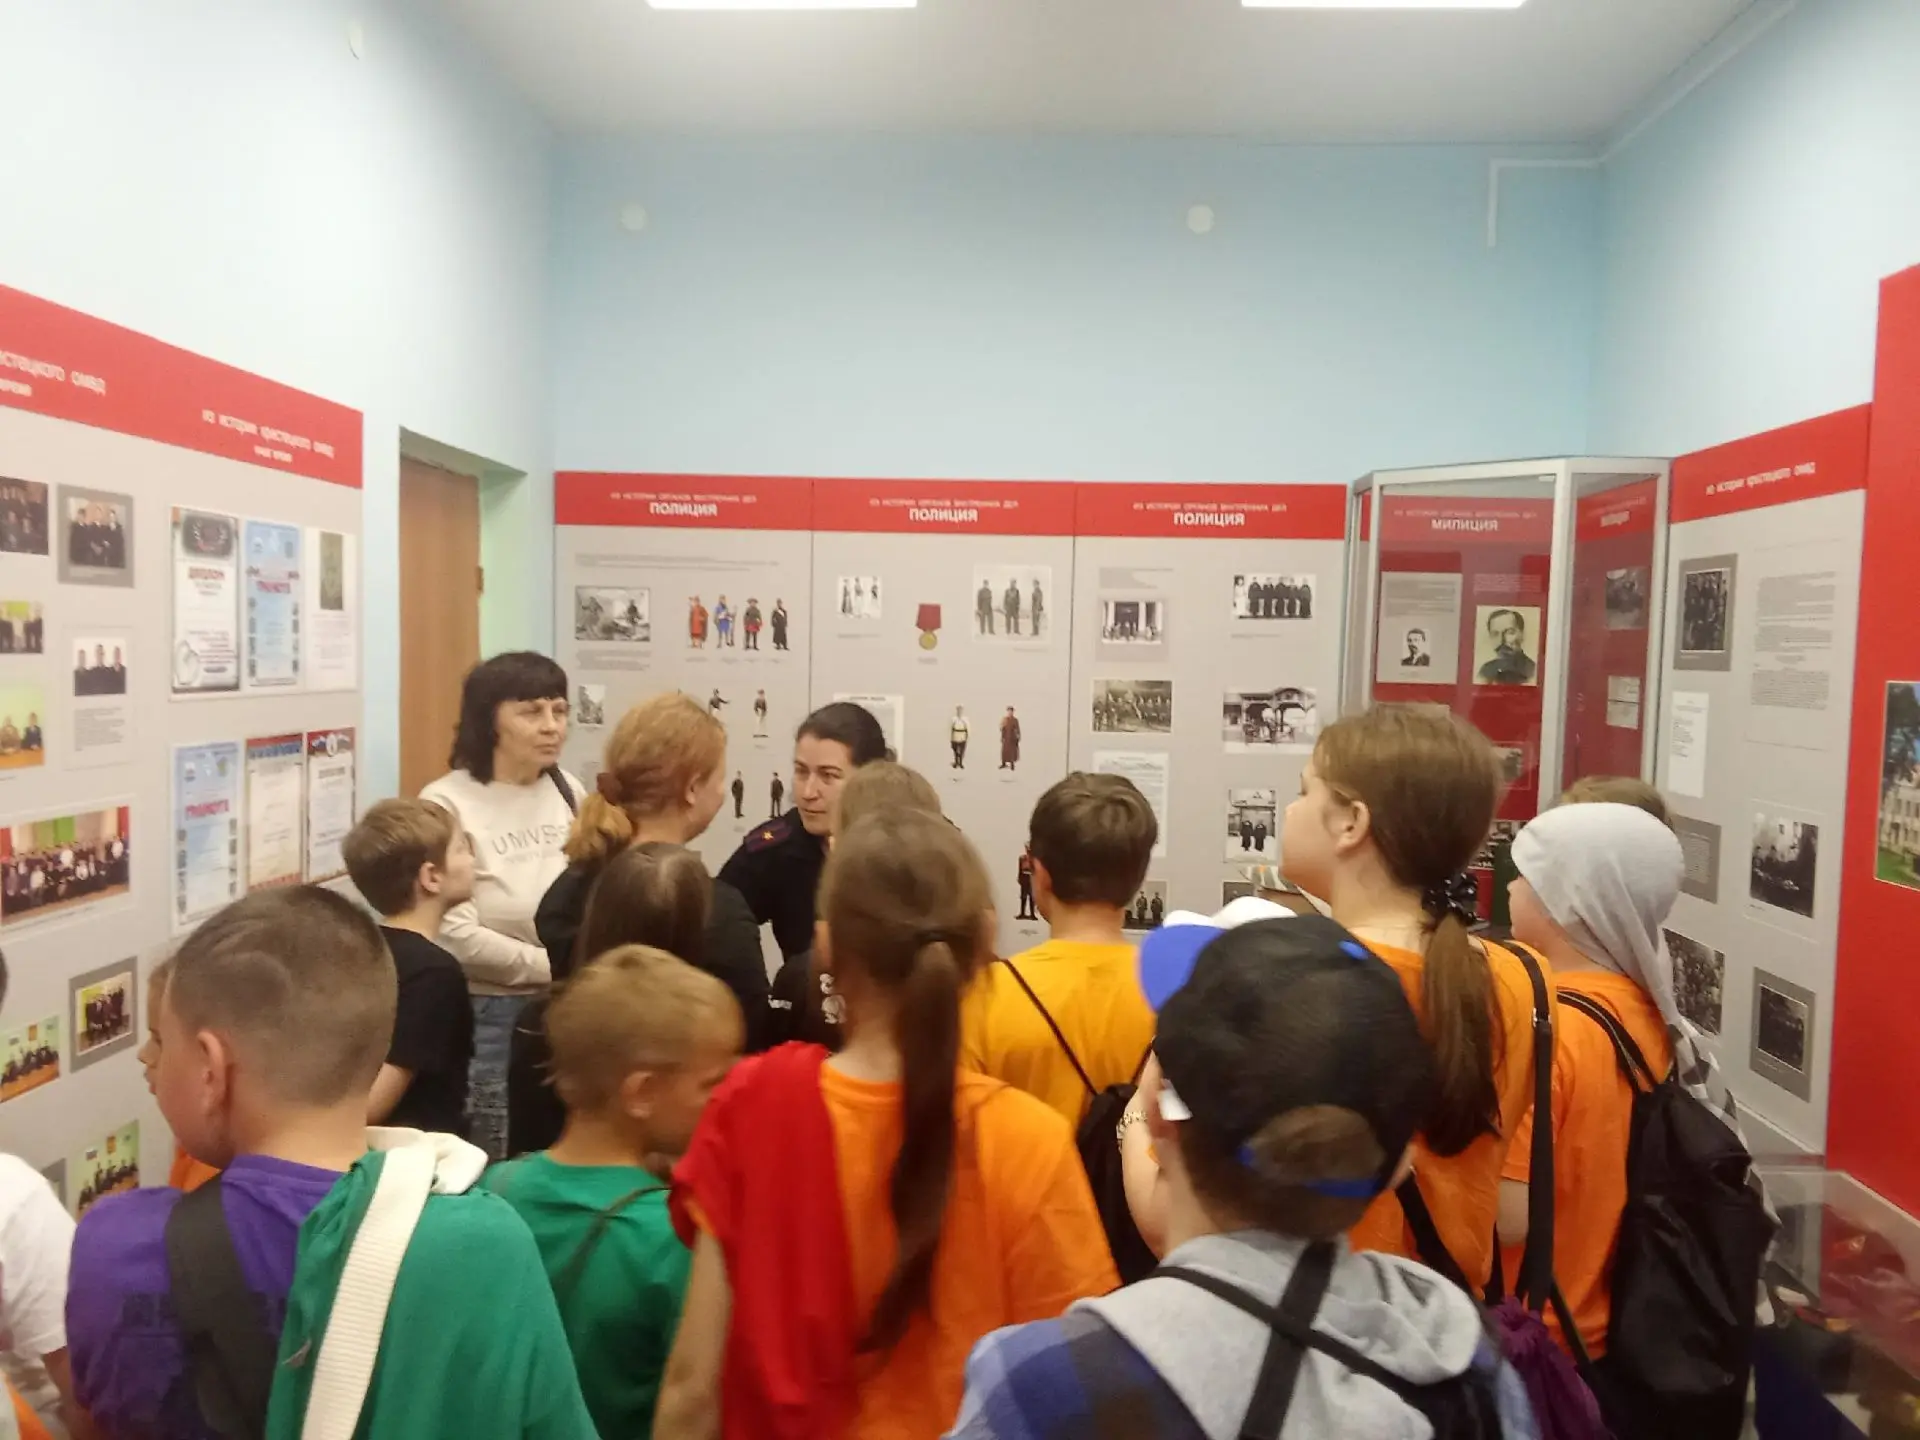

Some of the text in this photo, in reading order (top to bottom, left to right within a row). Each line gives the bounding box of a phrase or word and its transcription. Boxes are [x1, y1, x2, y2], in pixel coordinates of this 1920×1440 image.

[649, 502, 718, 517] ПОЛИЦИЯ
[909, 508, 978, 522] ПОЛИЦИЯ
[1173, 511, 1246, 527] ПОЛИЦИЯ
[1431, 518, 1499, 533] МИЛИЦИЯ
